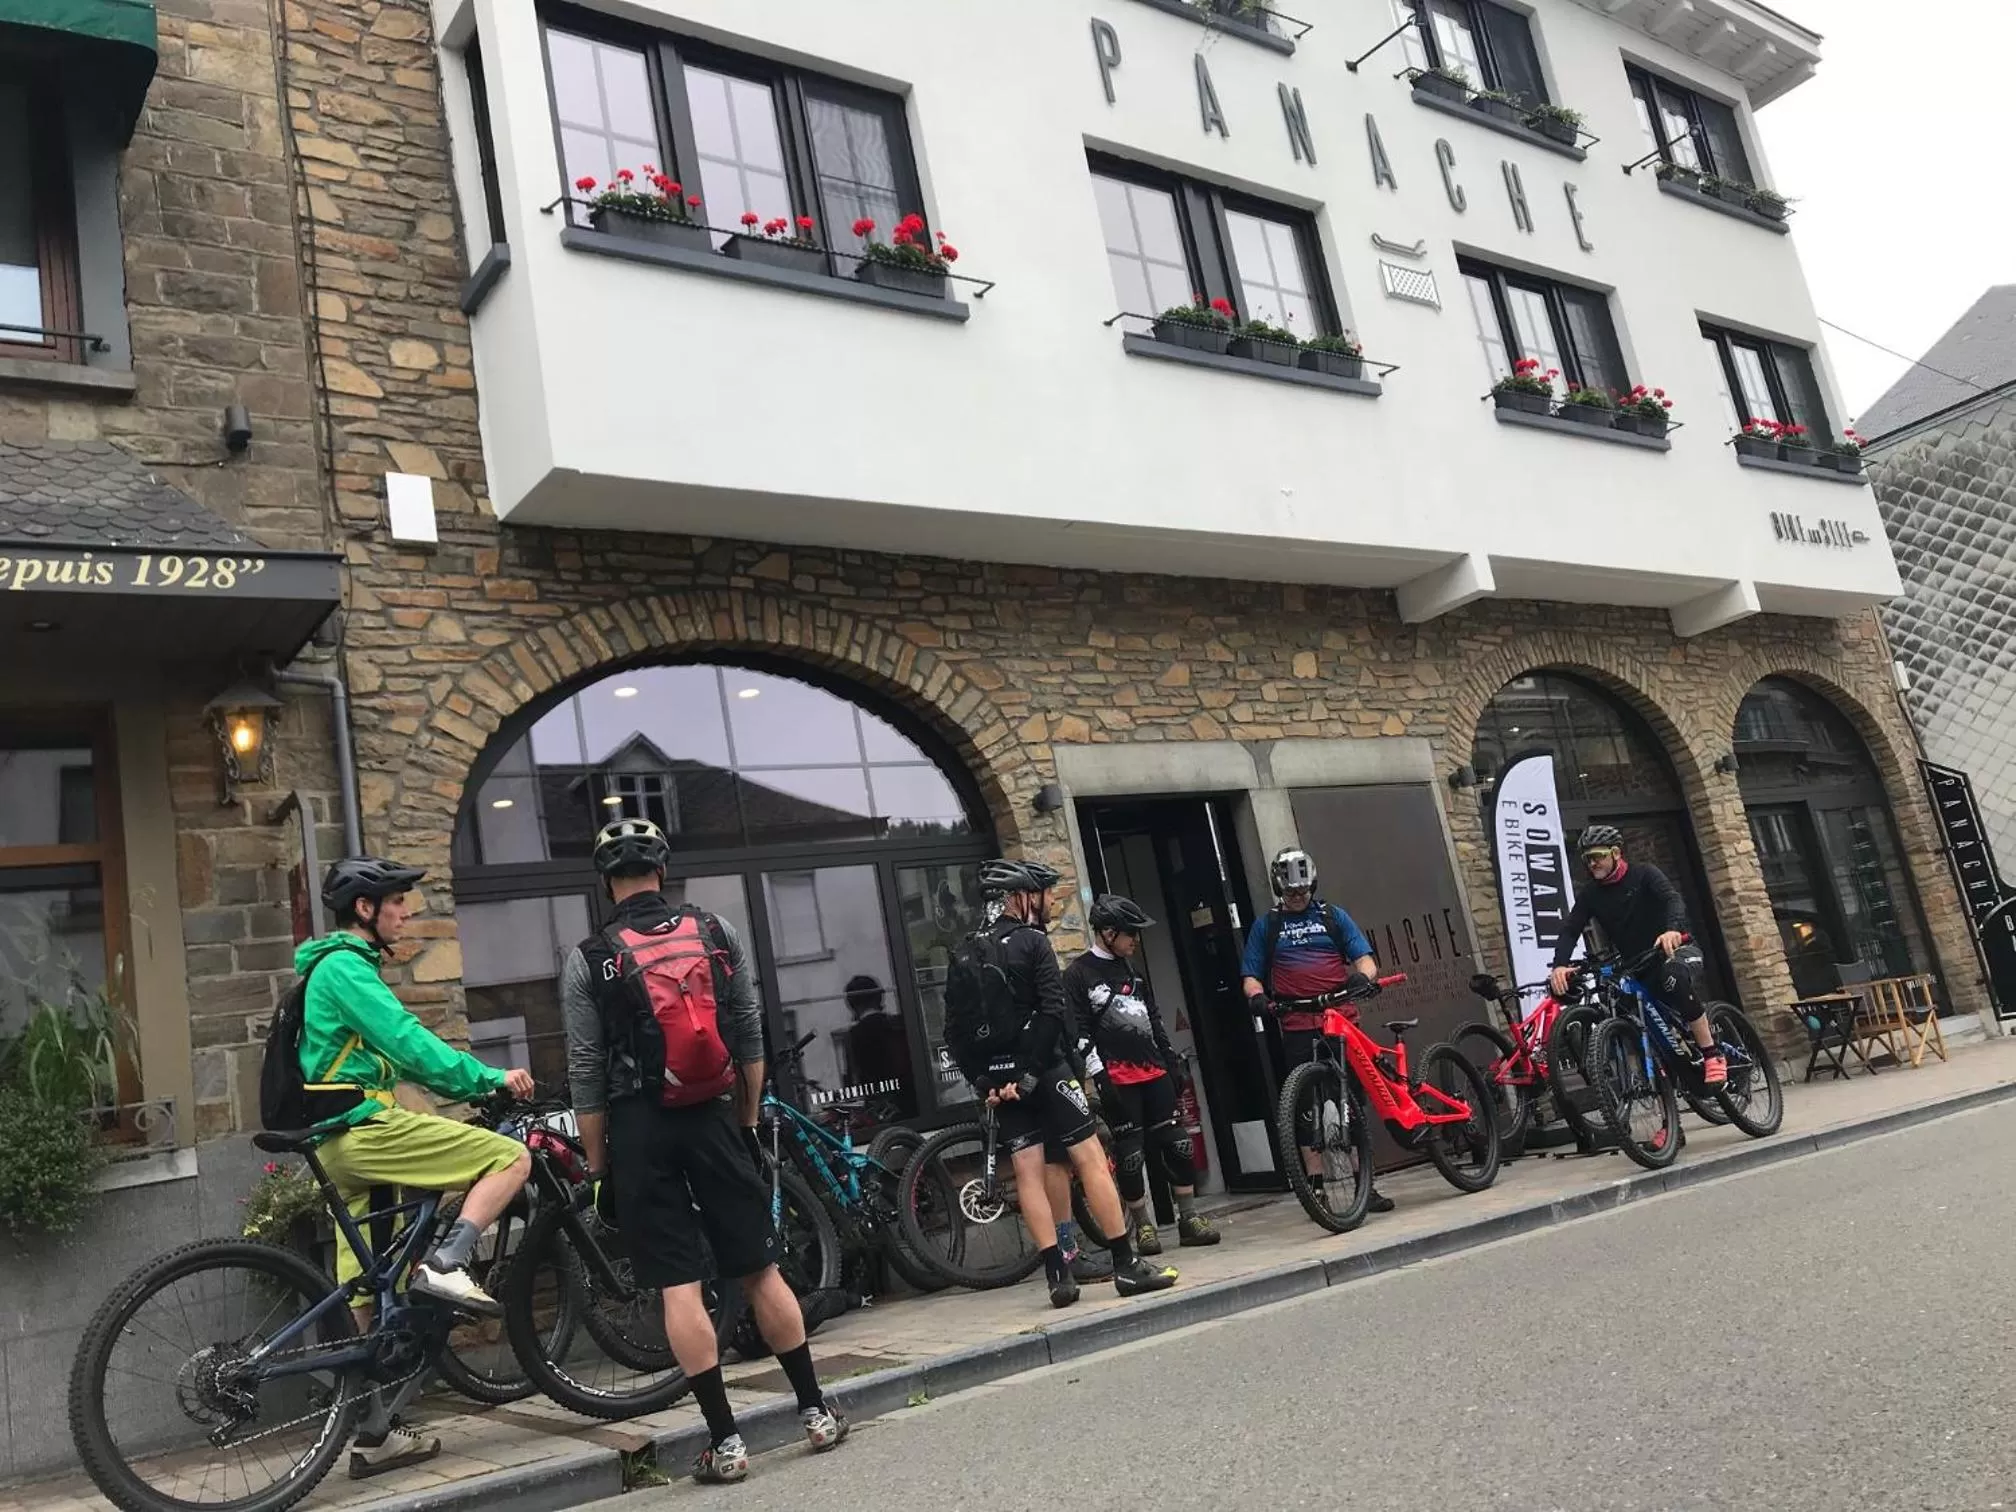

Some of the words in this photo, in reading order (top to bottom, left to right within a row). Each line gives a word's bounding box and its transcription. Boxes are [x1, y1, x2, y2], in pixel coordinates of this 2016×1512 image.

[1090, 16, 1595, 252] PANACHE
[1502, 800, 1518, 809] E
[1504, 818, 1524, 863] BIKE
[1937, 778, 1994, 909] PANACHE
[1364, 908, 1461, 969] NACHE
[1511, 871, 1535, 945] RENTAL
